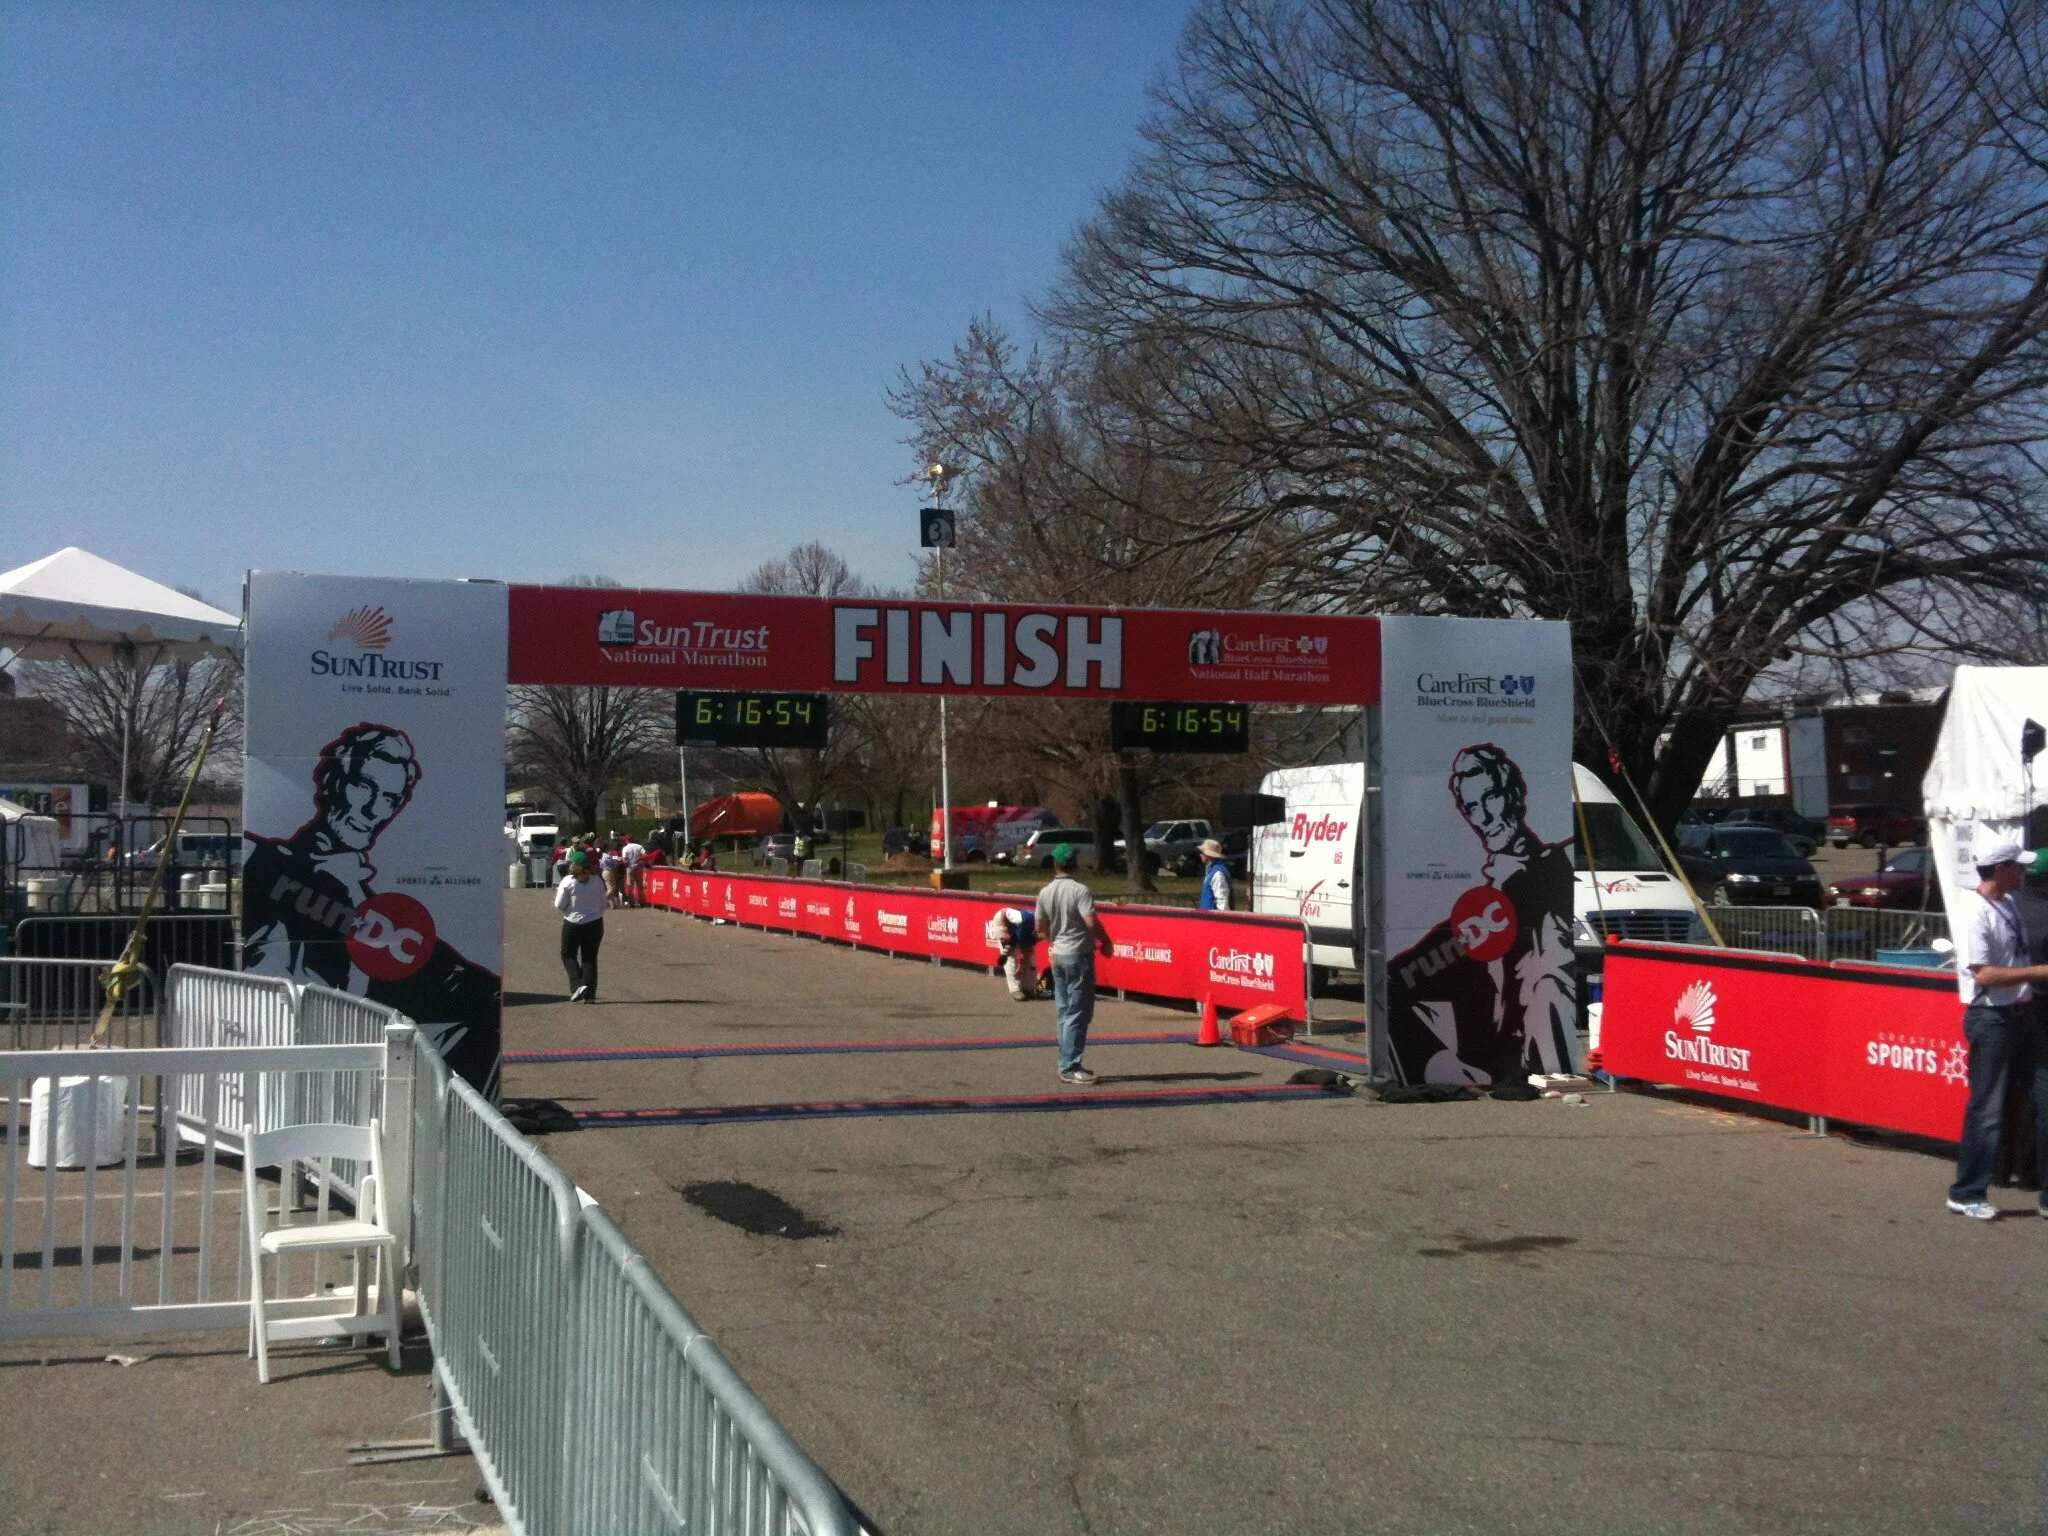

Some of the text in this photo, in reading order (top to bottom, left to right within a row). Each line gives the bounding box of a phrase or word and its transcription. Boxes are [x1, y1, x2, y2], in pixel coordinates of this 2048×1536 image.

[637, 619, 770, 650] SunTrust
[1223, 633, 1294, 653] CareFirst
[601, 648, 767, 667] National Marathon
[833, 606, 1123, 690] FINISH
[1190, 667, 1330, 683] National Half Marathon
[1417, 672, 1496, 695] CareFirst
[342, 683, 363, 693] Live
[398, 686, 422, 696] Bank
[1418, 695, 1536, 709] BlueCross BlueShield
[1291, 812, 1348, 847] Ryder
[1209, 946, 1251, 974] CareFirst
[1866, 1040, 1937, 1074] SPORTS
